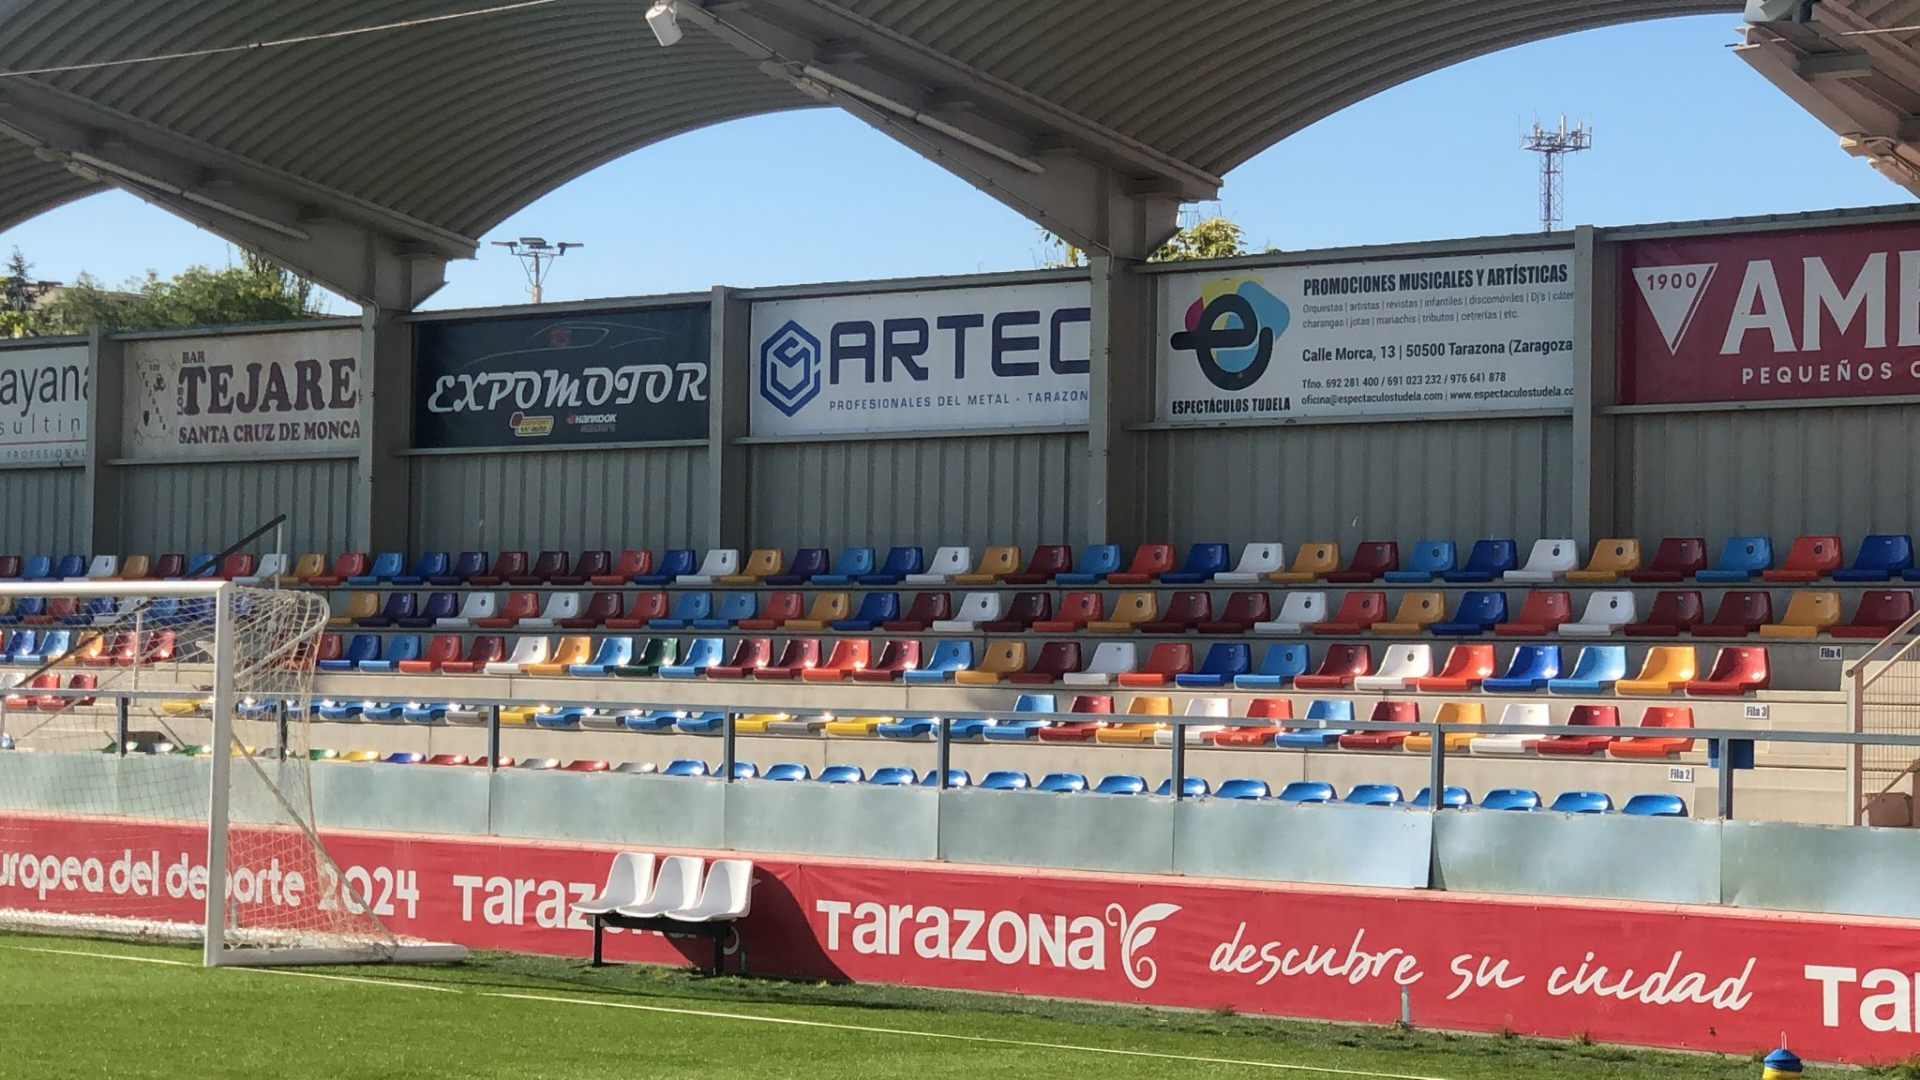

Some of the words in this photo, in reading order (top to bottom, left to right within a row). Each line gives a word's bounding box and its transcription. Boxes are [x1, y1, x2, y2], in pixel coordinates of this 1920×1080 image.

[1303, 274, 1396, 296] PROMOCIONES
[1399, 267, 1474, 291] MUSICALES
[1476, 268, 1485, 287] Y
[1487, 263, 1568, 287] ARTÍSTICAS
[1647, 272, 1697, 290] 1900
[1302, 303, 1343, 314] Orquestas
[1350, 301, 1380, 310] artistas
[1386, 299, 1418, 309] revistas
[1424, 296, 1463, 307] infantiles
[1302, 317, 1344, 329] charangas
[1349, 316, 1370, 328] jotas
[1376, 313, 1417, 325] mariachis
[1422, 311, 1455, 323] tributos
[182, 351, 205, 364] BAR
[830, 308, 1090, 385] ARTEC
[1302, 347, 1332, 361] Calle
[1335, 346, 1376, 362] Morca,
[1380, 345, 1396, 359] 13
[1405, 343, 1445, 358] 50500
[1448, 342, 1505, 356] Tarazona
[1508, 339, 1573, 356] (Zaragoza
[1326, 378, 1342, 388] 692
[1344, 377, 1359, 387] 281
[1362, 376, 1379, 387] 400
[1387, 376, 1403, 386] 691
[1406, 375, 1423, 385] 023
[1425, 374, 1442, 384] 232
[1450, 373, 1467, 383] 976
[1469, 372, 1485, 383] 641
[1488, 371, 1506, 382] 878
[1742, 359, 1892, 385] PEQUEÑOS
[179, 357, 361, 416] TEJARE
[427, 362, 707, 413] EXPOMOTOR
[829, 397, 931, 411] PROFESIONALES
[937, 394, 961, 407] DEL
[967, 393, 1010, 405] METAL
[1027, 389, 1089, 404] TARAZON
[1172, 398, 1249, 414] ESPECTÁCULOS
[1252, 397, 1291, 412] TUDELA
[1301, 391, 1443, 406] oficina@espectaculostudela.com
[179, 426, 230, 444] SANTA
[234, 424, 275, 441] CRUZ
[279, 422, 300, 440] DE
[304, 420, 360, 440] MONCA
[1820, 647, 1834, 658] Fila
[1835, 648, 1841, 658] 4
[1746, 706, 1760, 717] Fila
[1761, 706, 1767, 717] 3
[1670, 768, 1684, 779] Fila
[1685, 768, 1691, 780] 2
[109, 849, 159, 896] del
[318, 862, 420, 919] 2024
[1209, 921, 1424, 986] descubre
[1446, 953, 1526, 1000] su
[1547, 950, 1756, 1012] ciudad
[1804, 964, 1920, 1033] Ta
